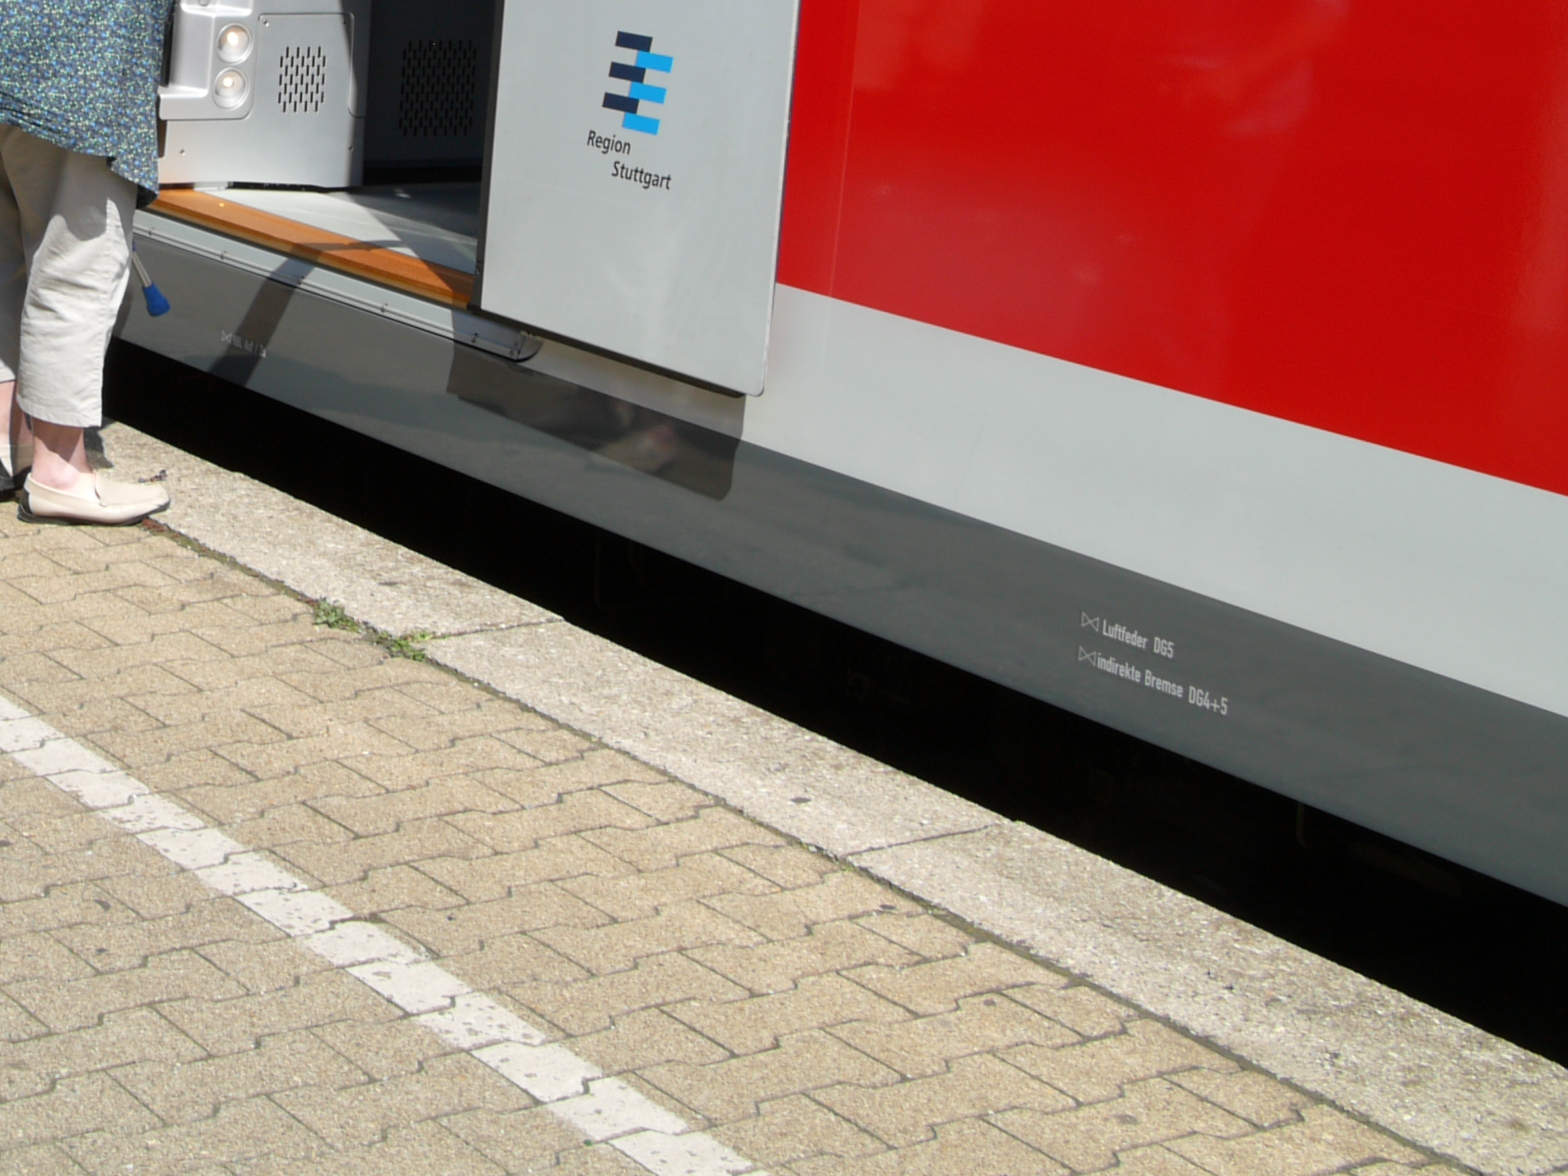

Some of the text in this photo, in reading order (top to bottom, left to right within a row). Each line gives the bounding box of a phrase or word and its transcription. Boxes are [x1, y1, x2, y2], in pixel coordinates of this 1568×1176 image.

[586, 129, 632, 156] Region
[611, 160, 672, 190] Stuttgart
[1102, 619, 1175, 659] Luftfeder DG5
[1096, 652, 1229, 715] indirekte Bremse DG4+5
